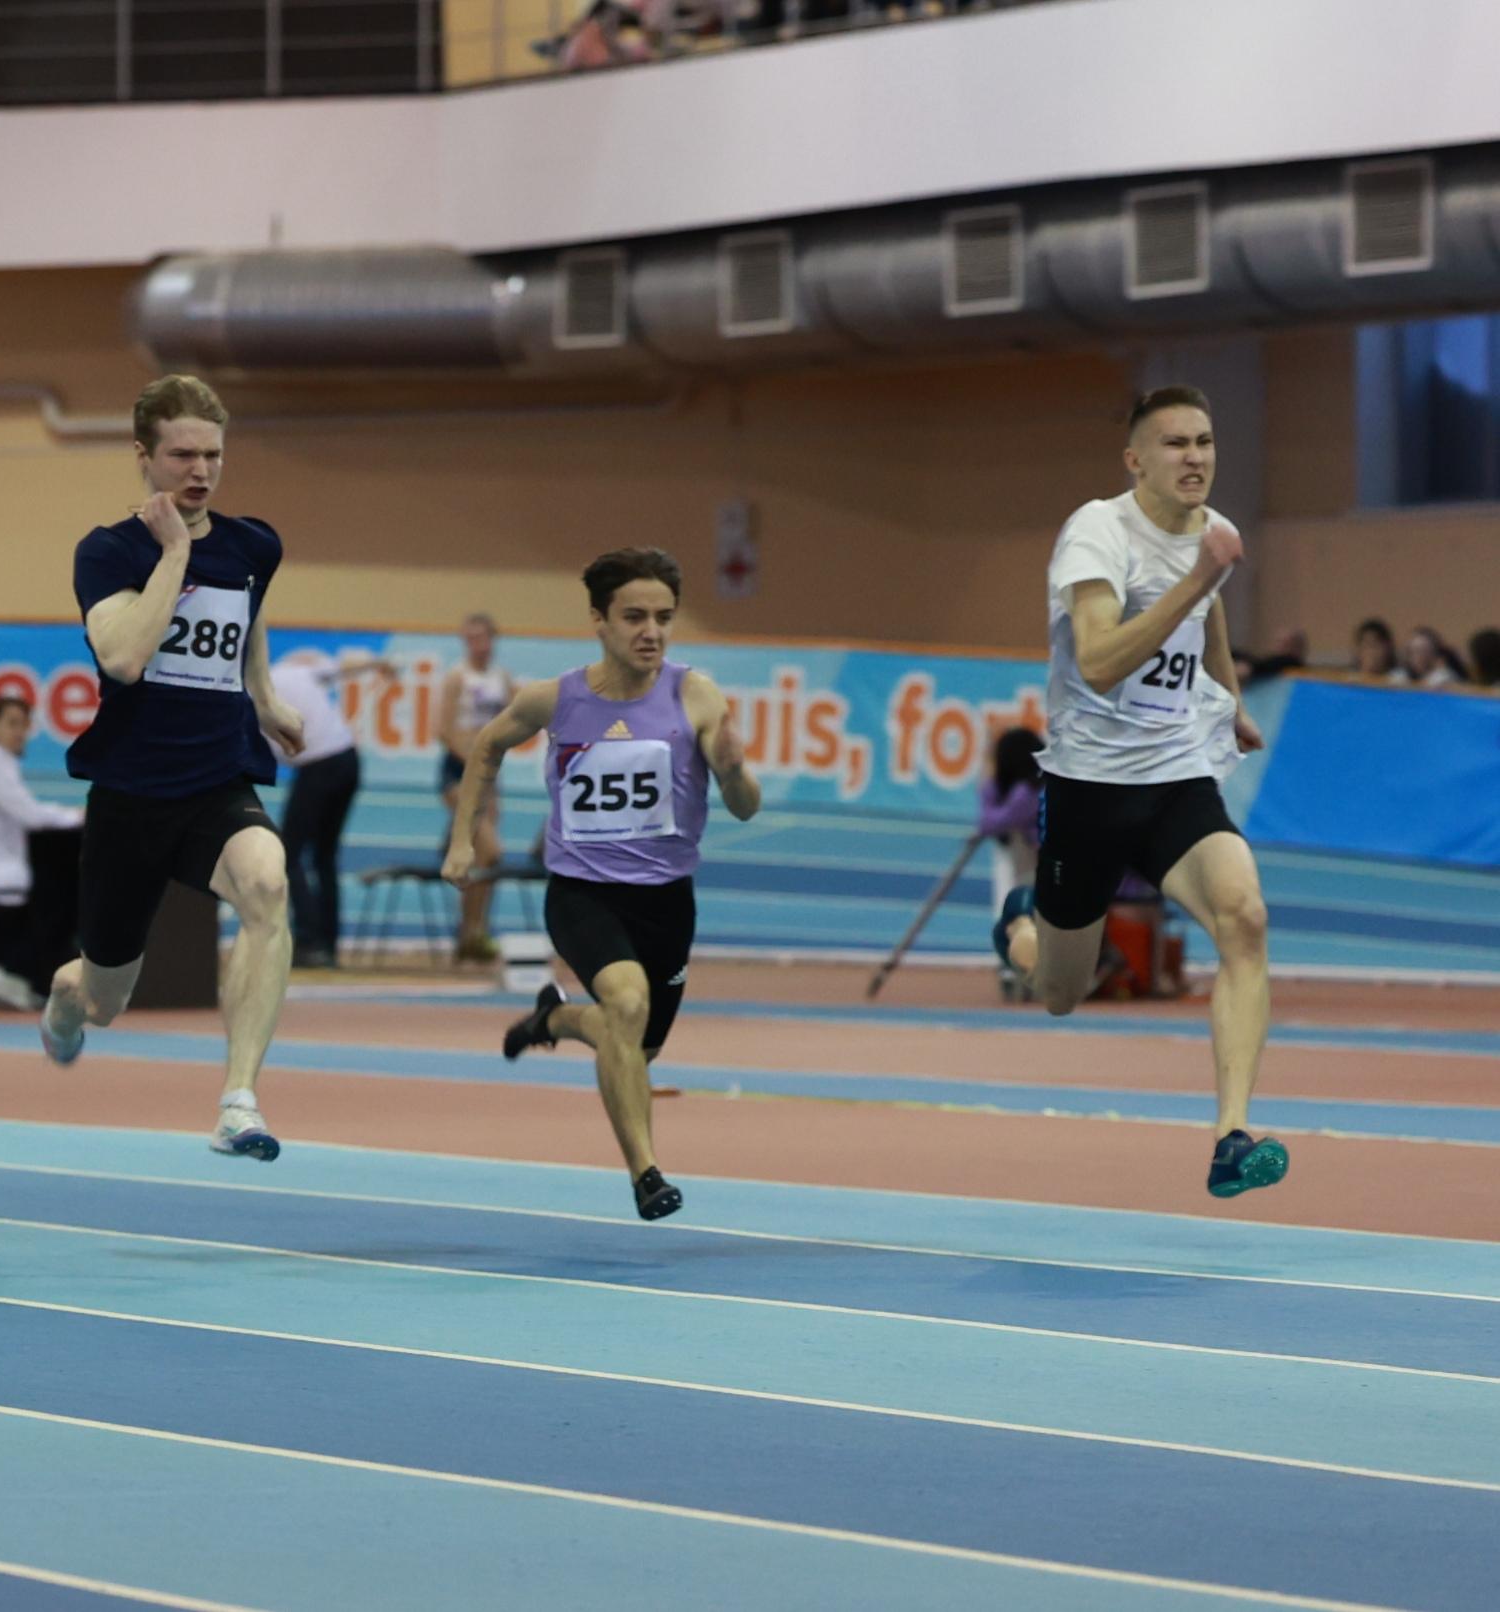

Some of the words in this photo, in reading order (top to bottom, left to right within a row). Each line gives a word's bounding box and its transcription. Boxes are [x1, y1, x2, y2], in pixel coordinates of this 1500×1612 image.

[158, 616, 241, 661] 288
[1141, 649, 1197, 691] 291
[569, 771, 661, 812] 255
